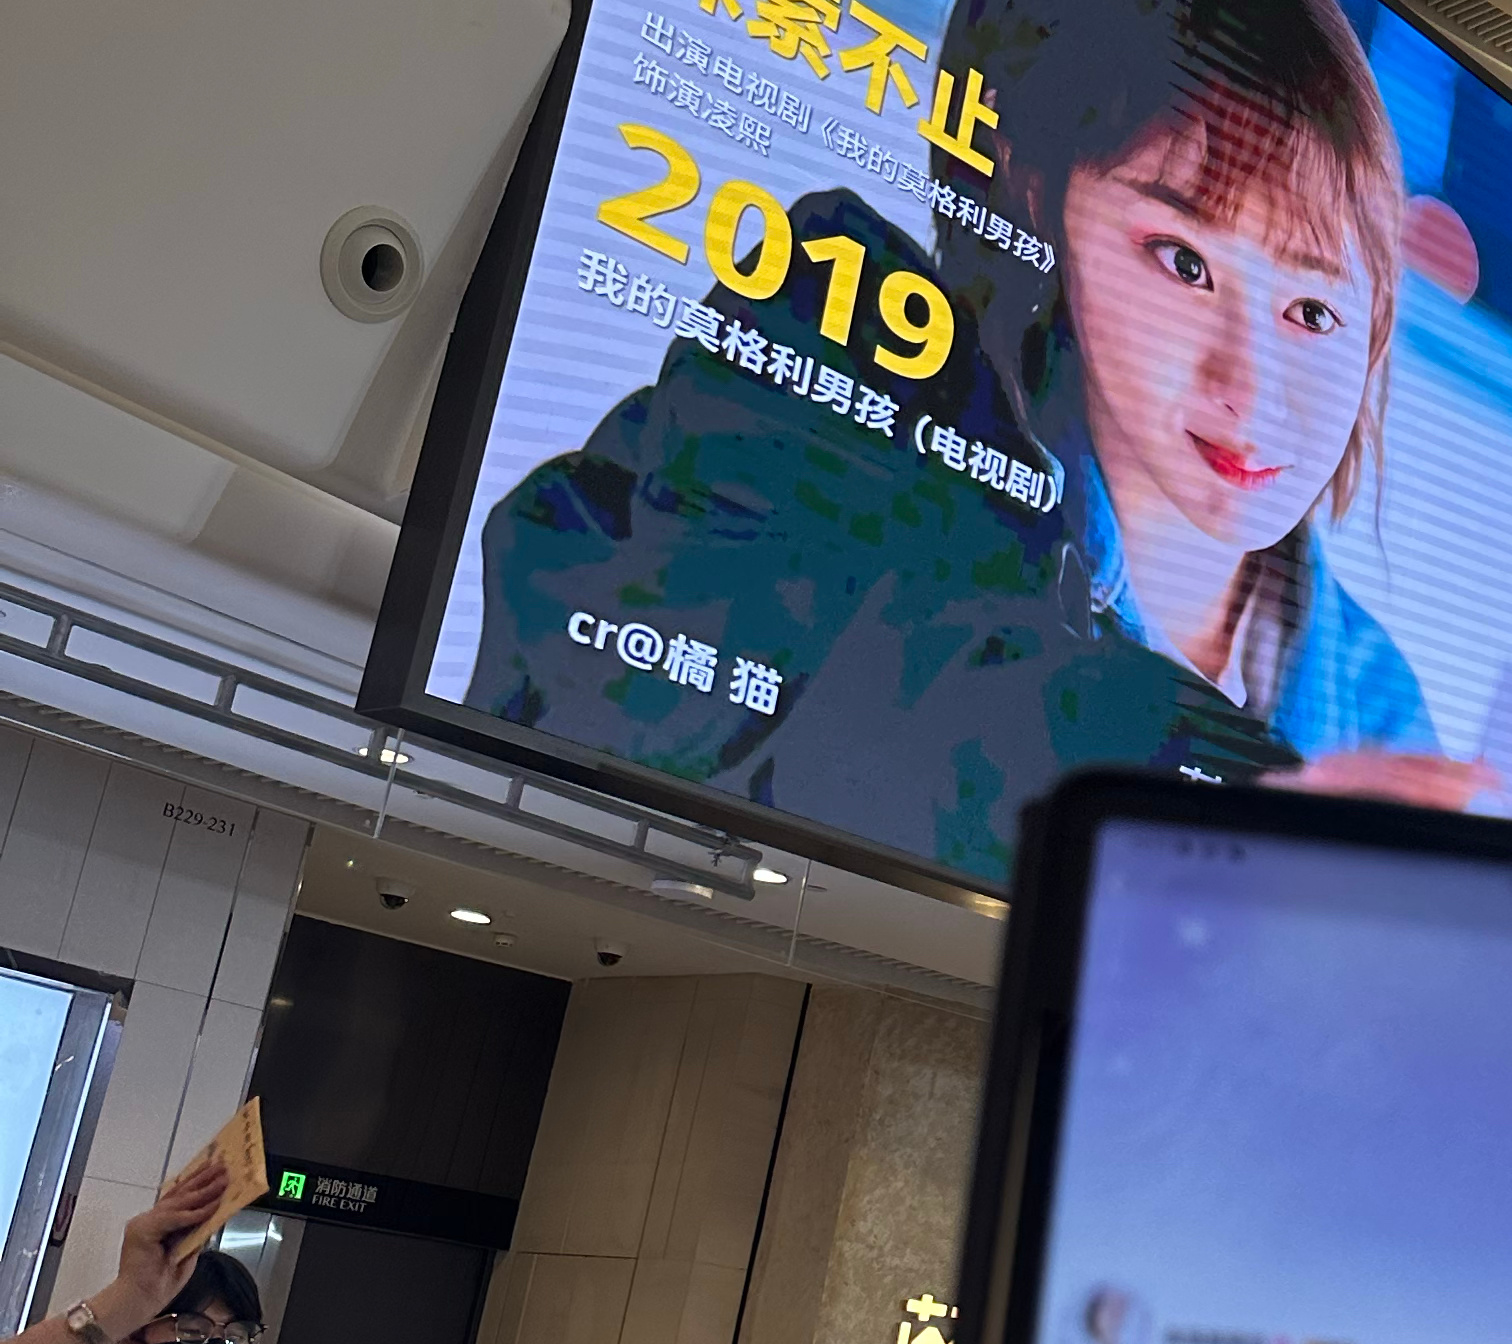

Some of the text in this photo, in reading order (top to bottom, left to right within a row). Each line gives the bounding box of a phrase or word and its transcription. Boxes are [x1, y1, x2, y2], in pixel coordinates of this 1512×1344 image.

[632, 51, 773, 159] 饰演凌熙
[640, 11, 1057, 275] 出演电视剧《我的莫格利男孩》
[596, 122, 956, 380] 2019
[729, 655, 784, 717] 猫
[162, 801, 236, 837] B229-231
[311, 1194, 368, 1214] FIRE EXIT
[314, 1175, 379, 1204] 消防通道
